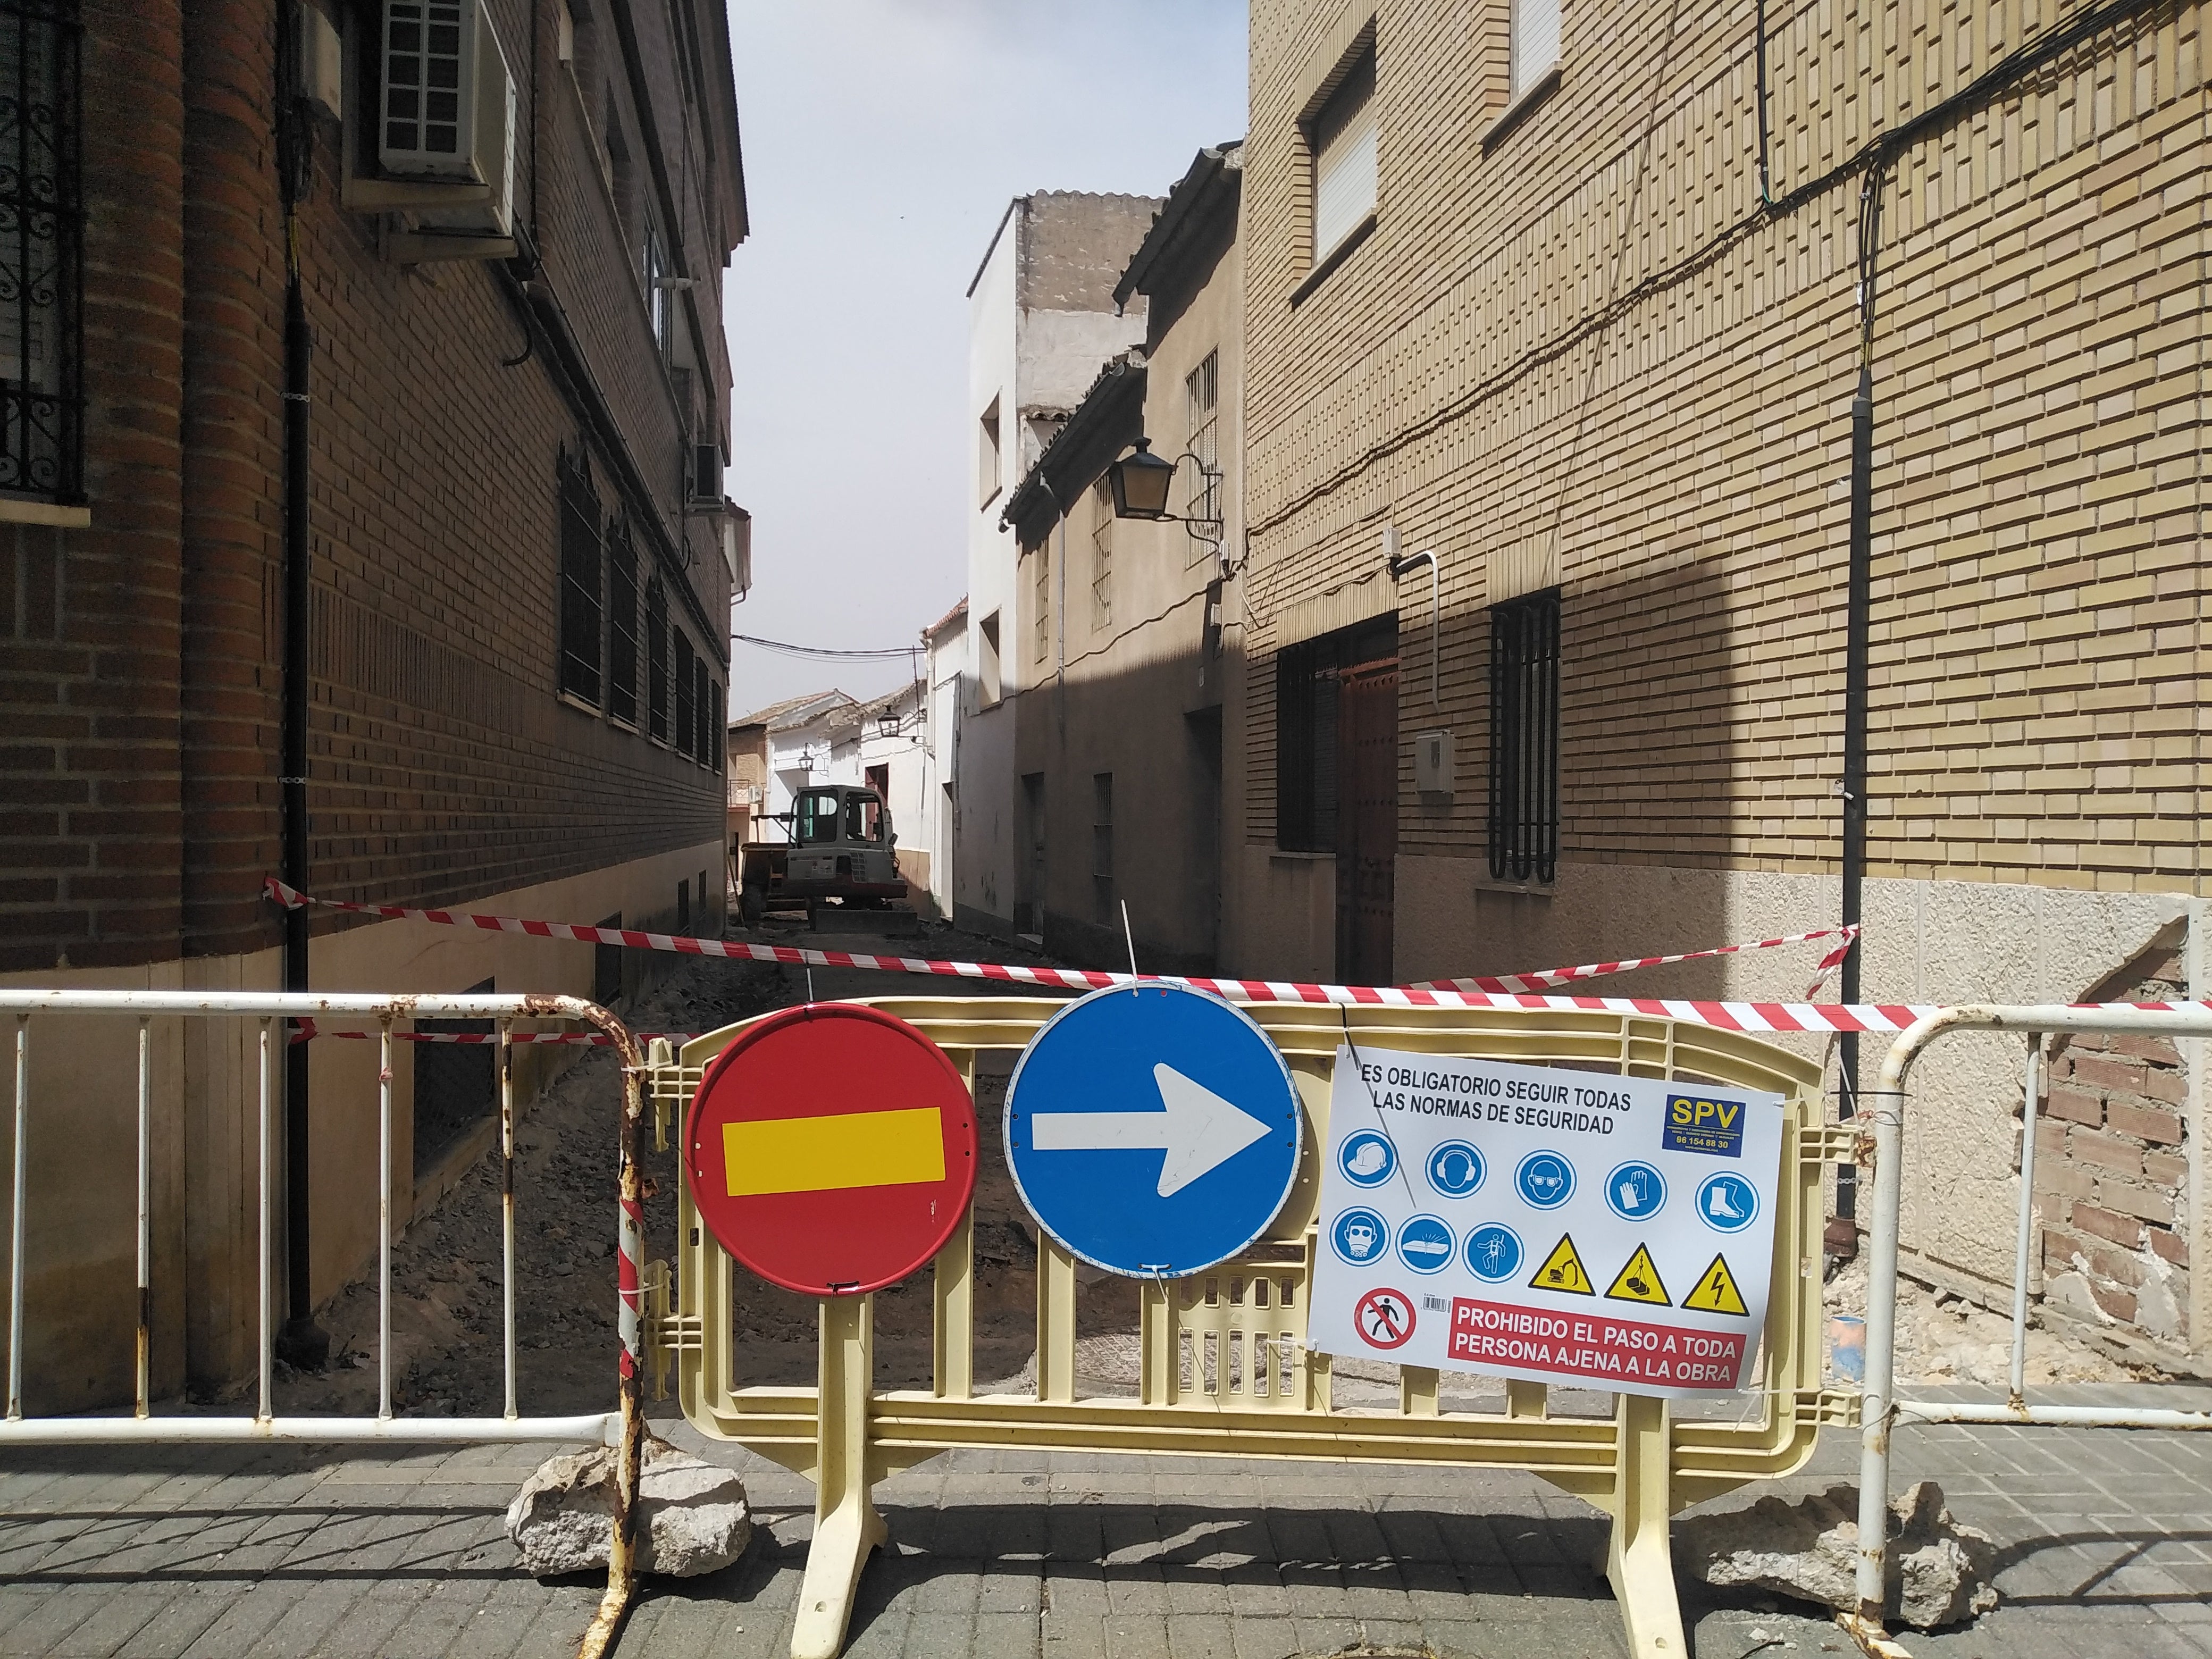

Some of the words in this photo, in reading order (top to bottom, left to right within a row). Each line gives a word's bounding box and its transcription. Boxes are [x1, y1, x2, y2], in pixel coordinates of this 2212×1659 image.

[1361, 1063, 1382, 1083] ES
[1388, 1067, 1501, 1096] OBLIGATORIO
[1506, 1080, 1568, 1104] SEGUIR
[1574, 1088, 1631, 1111] TODAS
[1373, 1091, 1405, 1110] LAS
[1410, 1094, 1482, 1119] NORMAS
[1487, 1103, 1510, 1122] DE
[1514, 1107, 1613, 1134] SEGURIDAD
[1672, 1099, 1738, 1128] SPV
[1689, 1137, 1704, 1146] 154
[1457, 1306, 1568, 1339] PROHIBIDO
[1573, 1322, 1598, 1344] EL
[1604, 1326, 1658, 1351] PASO
[1662, 1335, 1677, 1354] A
[1682, 1336, 1736, 1359] TODA
[1455, 1332, 1551, 1363] PERSONA
[1554, 1347, 1621, 1372] AJENA
[1624, 1356, 1640, 1375] A
[1645, 1358, 1670, 1379] LA
[1676, 1362, 1731, 1381] OBRA
